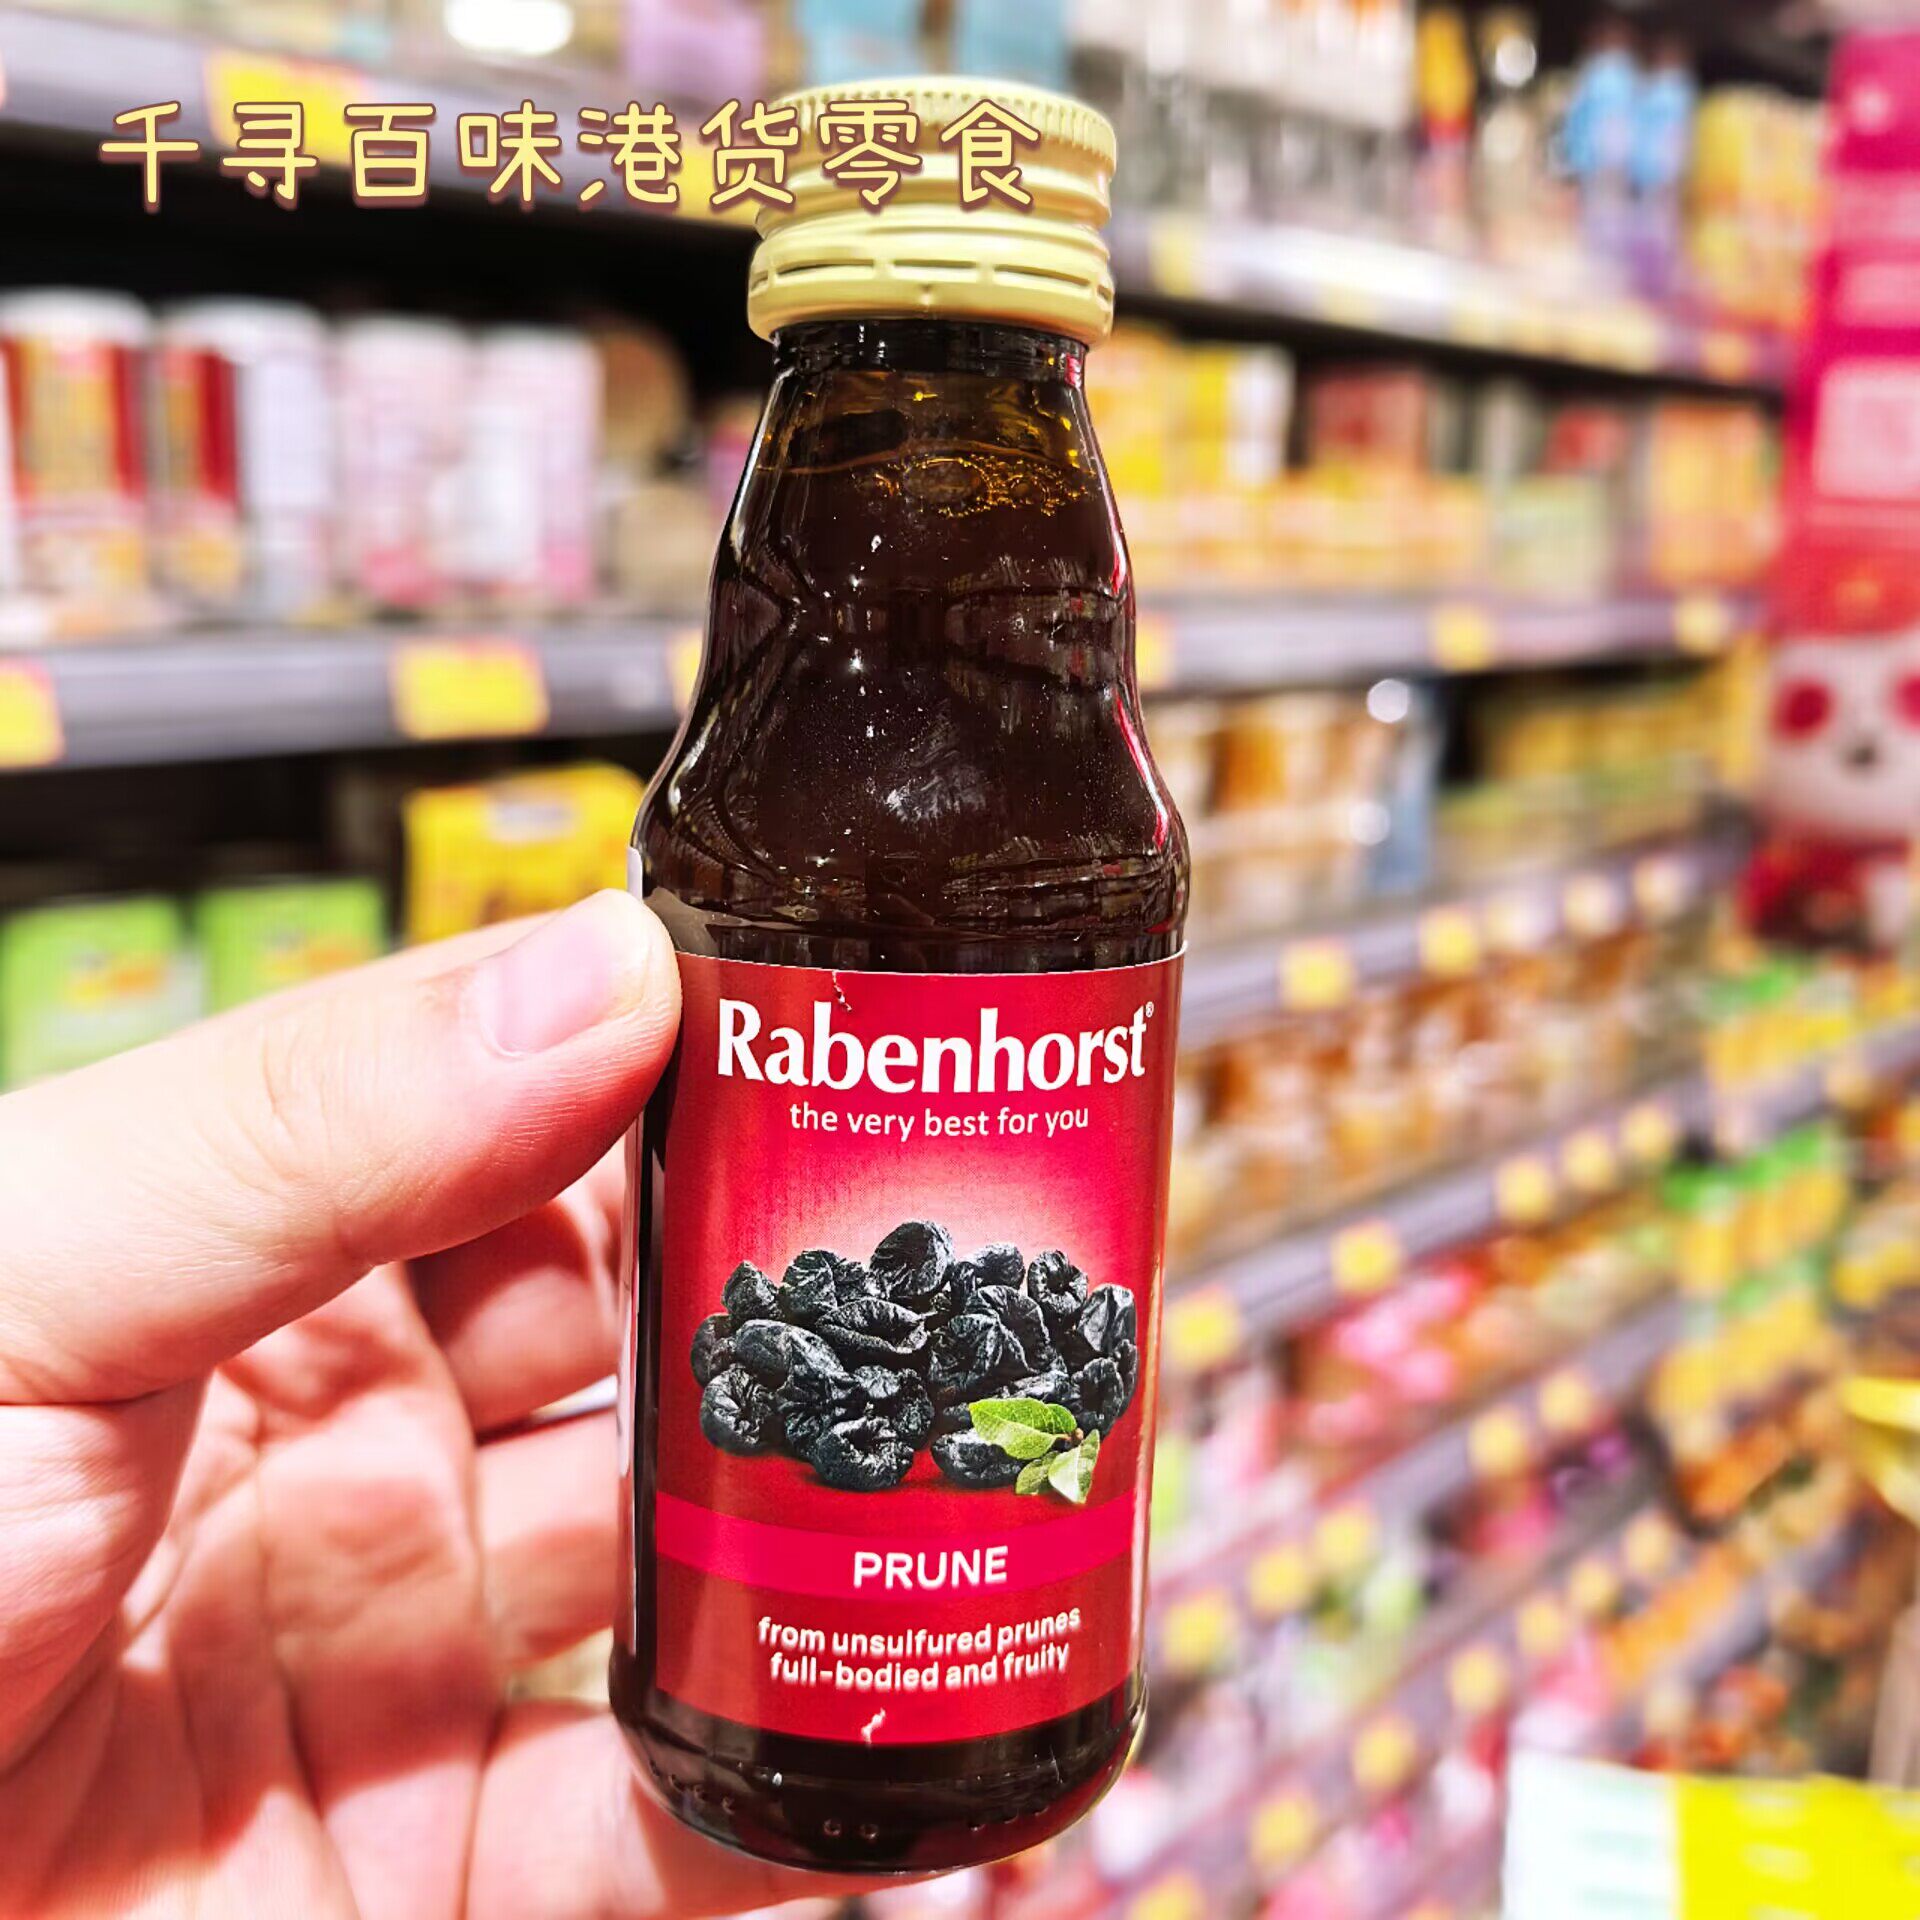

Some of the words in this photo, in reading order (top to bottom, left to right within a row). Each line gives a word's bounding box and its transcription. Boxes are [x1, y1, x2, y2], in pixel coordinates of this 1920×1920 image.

[789, 1103, 838, 1133] the
[847, 1110, 915, 1142] very
[924, 1108, 989, 1137] best
[997, 1106, 1037, 1135] for
[1045, 1108, 1090, 1137] you
[852, 1545, 1009, 1591] PRUNE
[758, 1616, 826, 1653] from
[832, 1622, 992, 1656] unsulfured
[997, 1607, 1081, 1651] prunes
[769, 1653, 940, 1690] full-bodied
[946, 1658, 998, 1688] and
[1003, 1641, 1070, 1684] fruity
